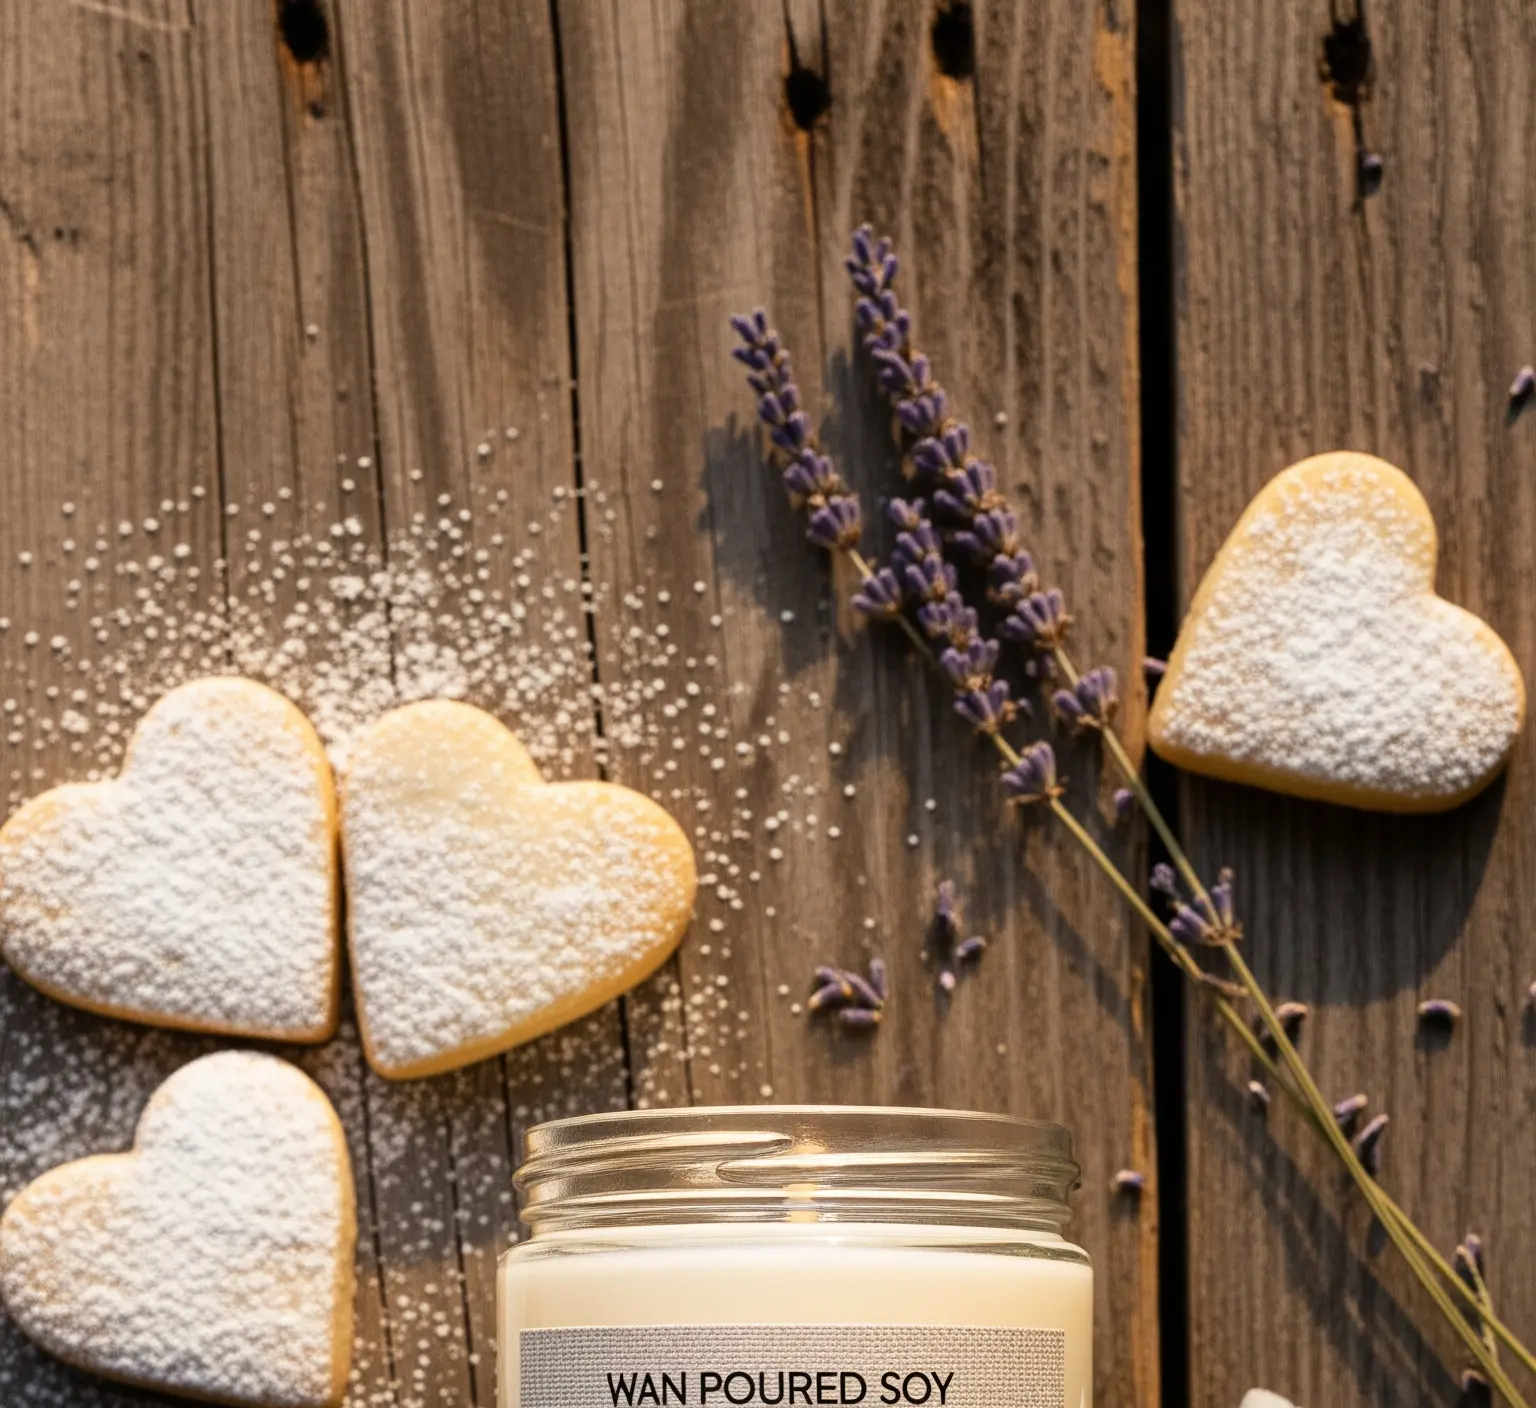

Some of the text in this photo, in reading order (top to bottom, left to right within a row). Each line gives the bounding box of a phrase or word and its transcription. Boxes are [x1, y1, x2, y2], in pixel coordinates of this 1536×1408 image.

[606, 1371, 955, 1408] WAN POURED SOY
